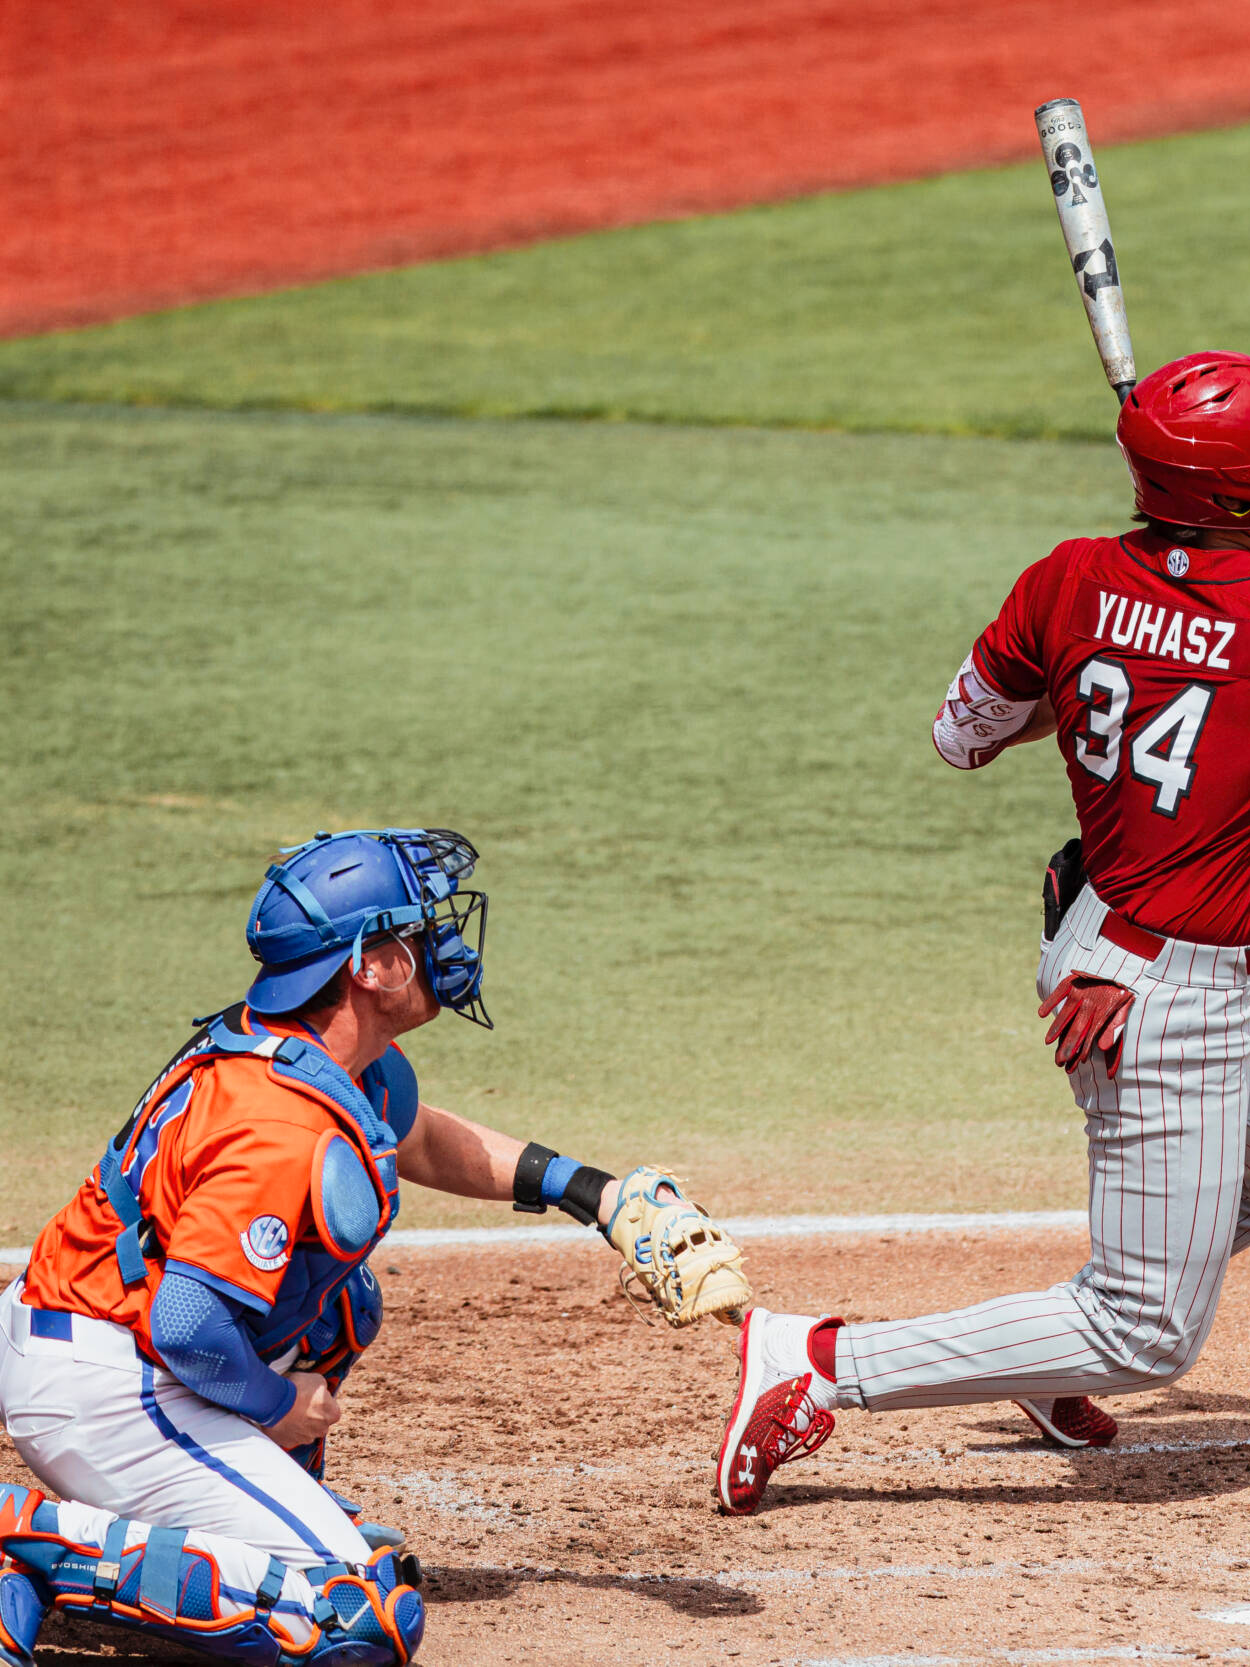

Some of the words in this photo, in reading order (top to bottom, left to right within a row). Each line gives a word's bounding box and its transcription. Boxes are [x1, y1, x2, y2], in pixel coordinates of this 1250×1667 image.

[1094, 591, 1236, 670] YUHASZ
[1074, 655, 1217, 819] 34
[249, 1215, 288, 1257] SEC
[51, 1562, 97, 1572] EVOSHIE
